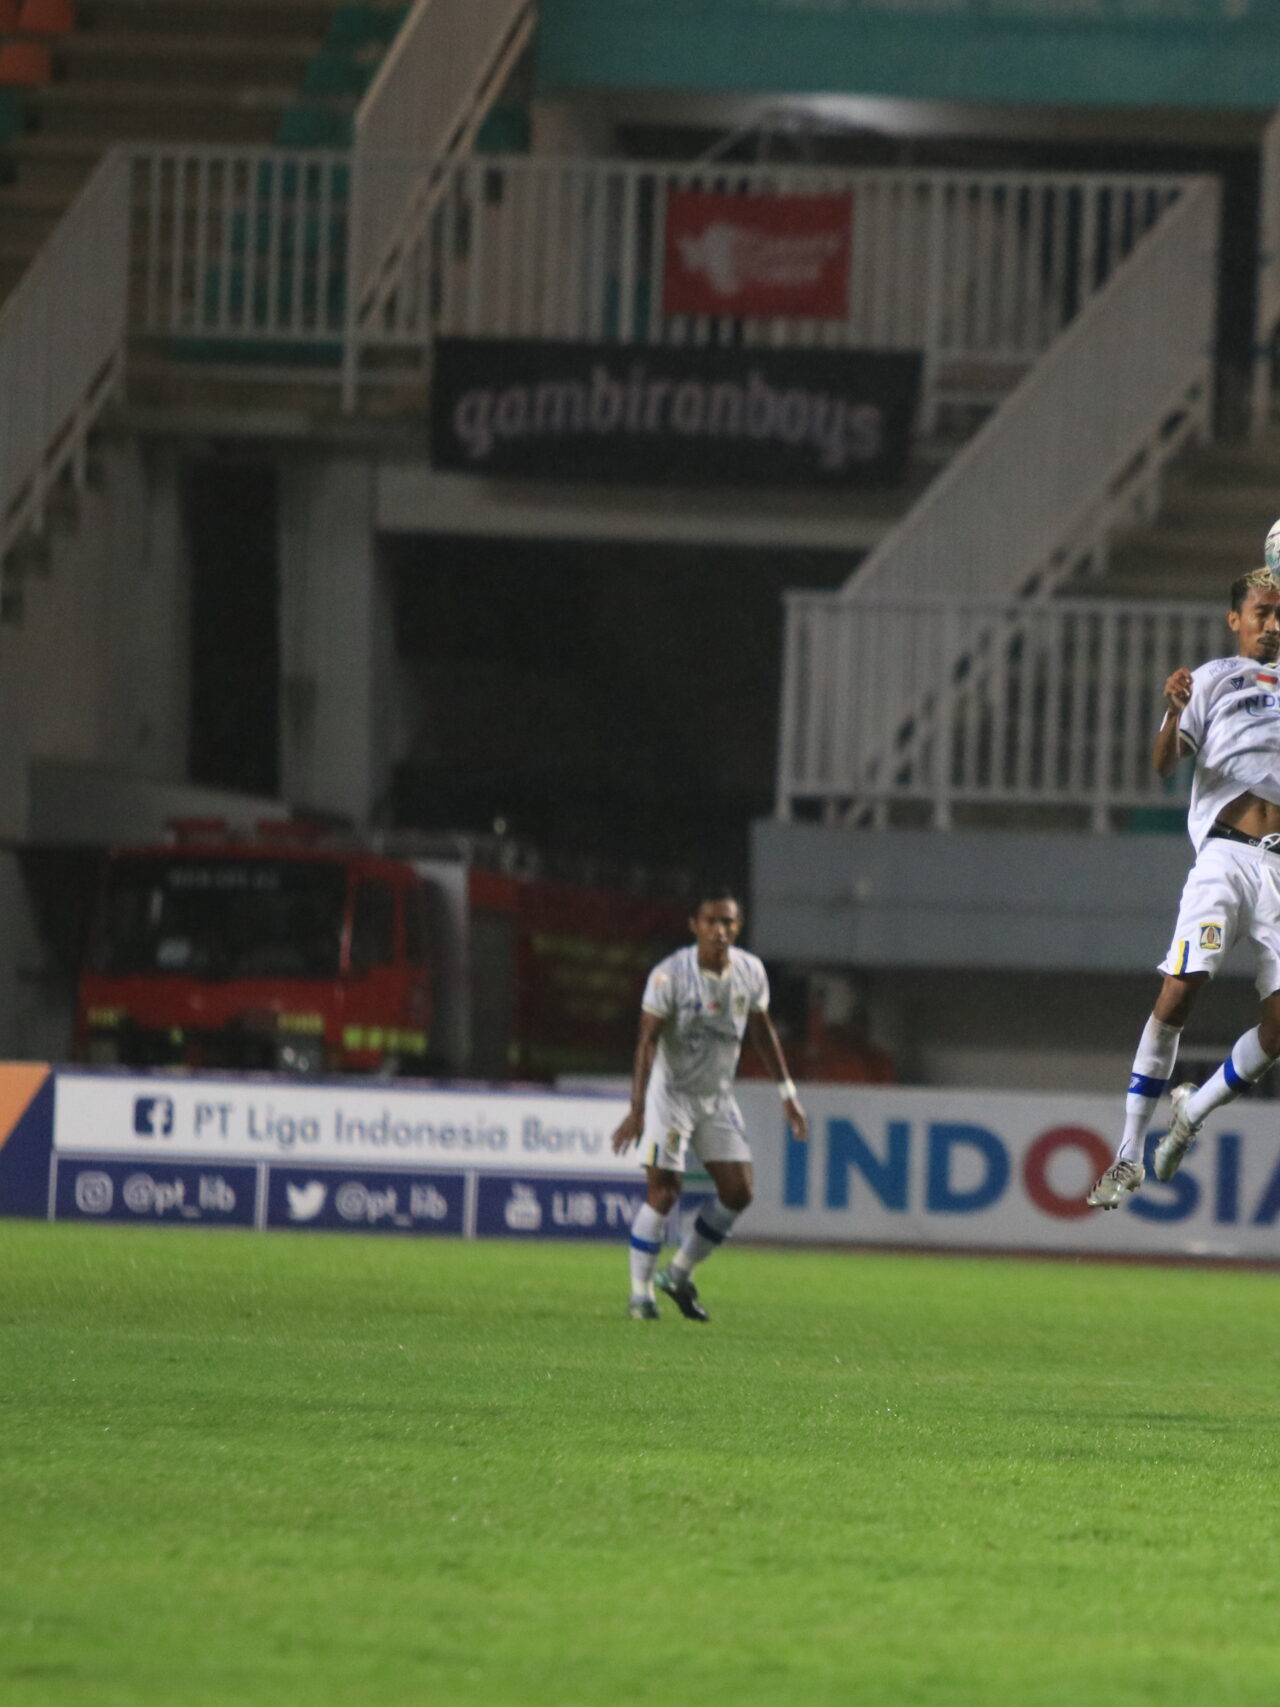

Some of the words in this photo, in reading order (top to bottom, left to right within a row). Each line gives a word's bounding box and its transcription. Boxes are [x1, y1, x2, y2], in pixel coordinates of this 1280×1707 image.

[194, 1104, 230, 1137] PT
[247, 1105, 321, 1148] Liga
[335, 1108, 509, 1153] Indonesia
[522, 1117, 603, 1154] Baru
[123, 1173, 235, 1218] @pt_lib
[336, 1181, 447, 1227] @pt_lib
[552, 1192, 597, 1226] LIB
